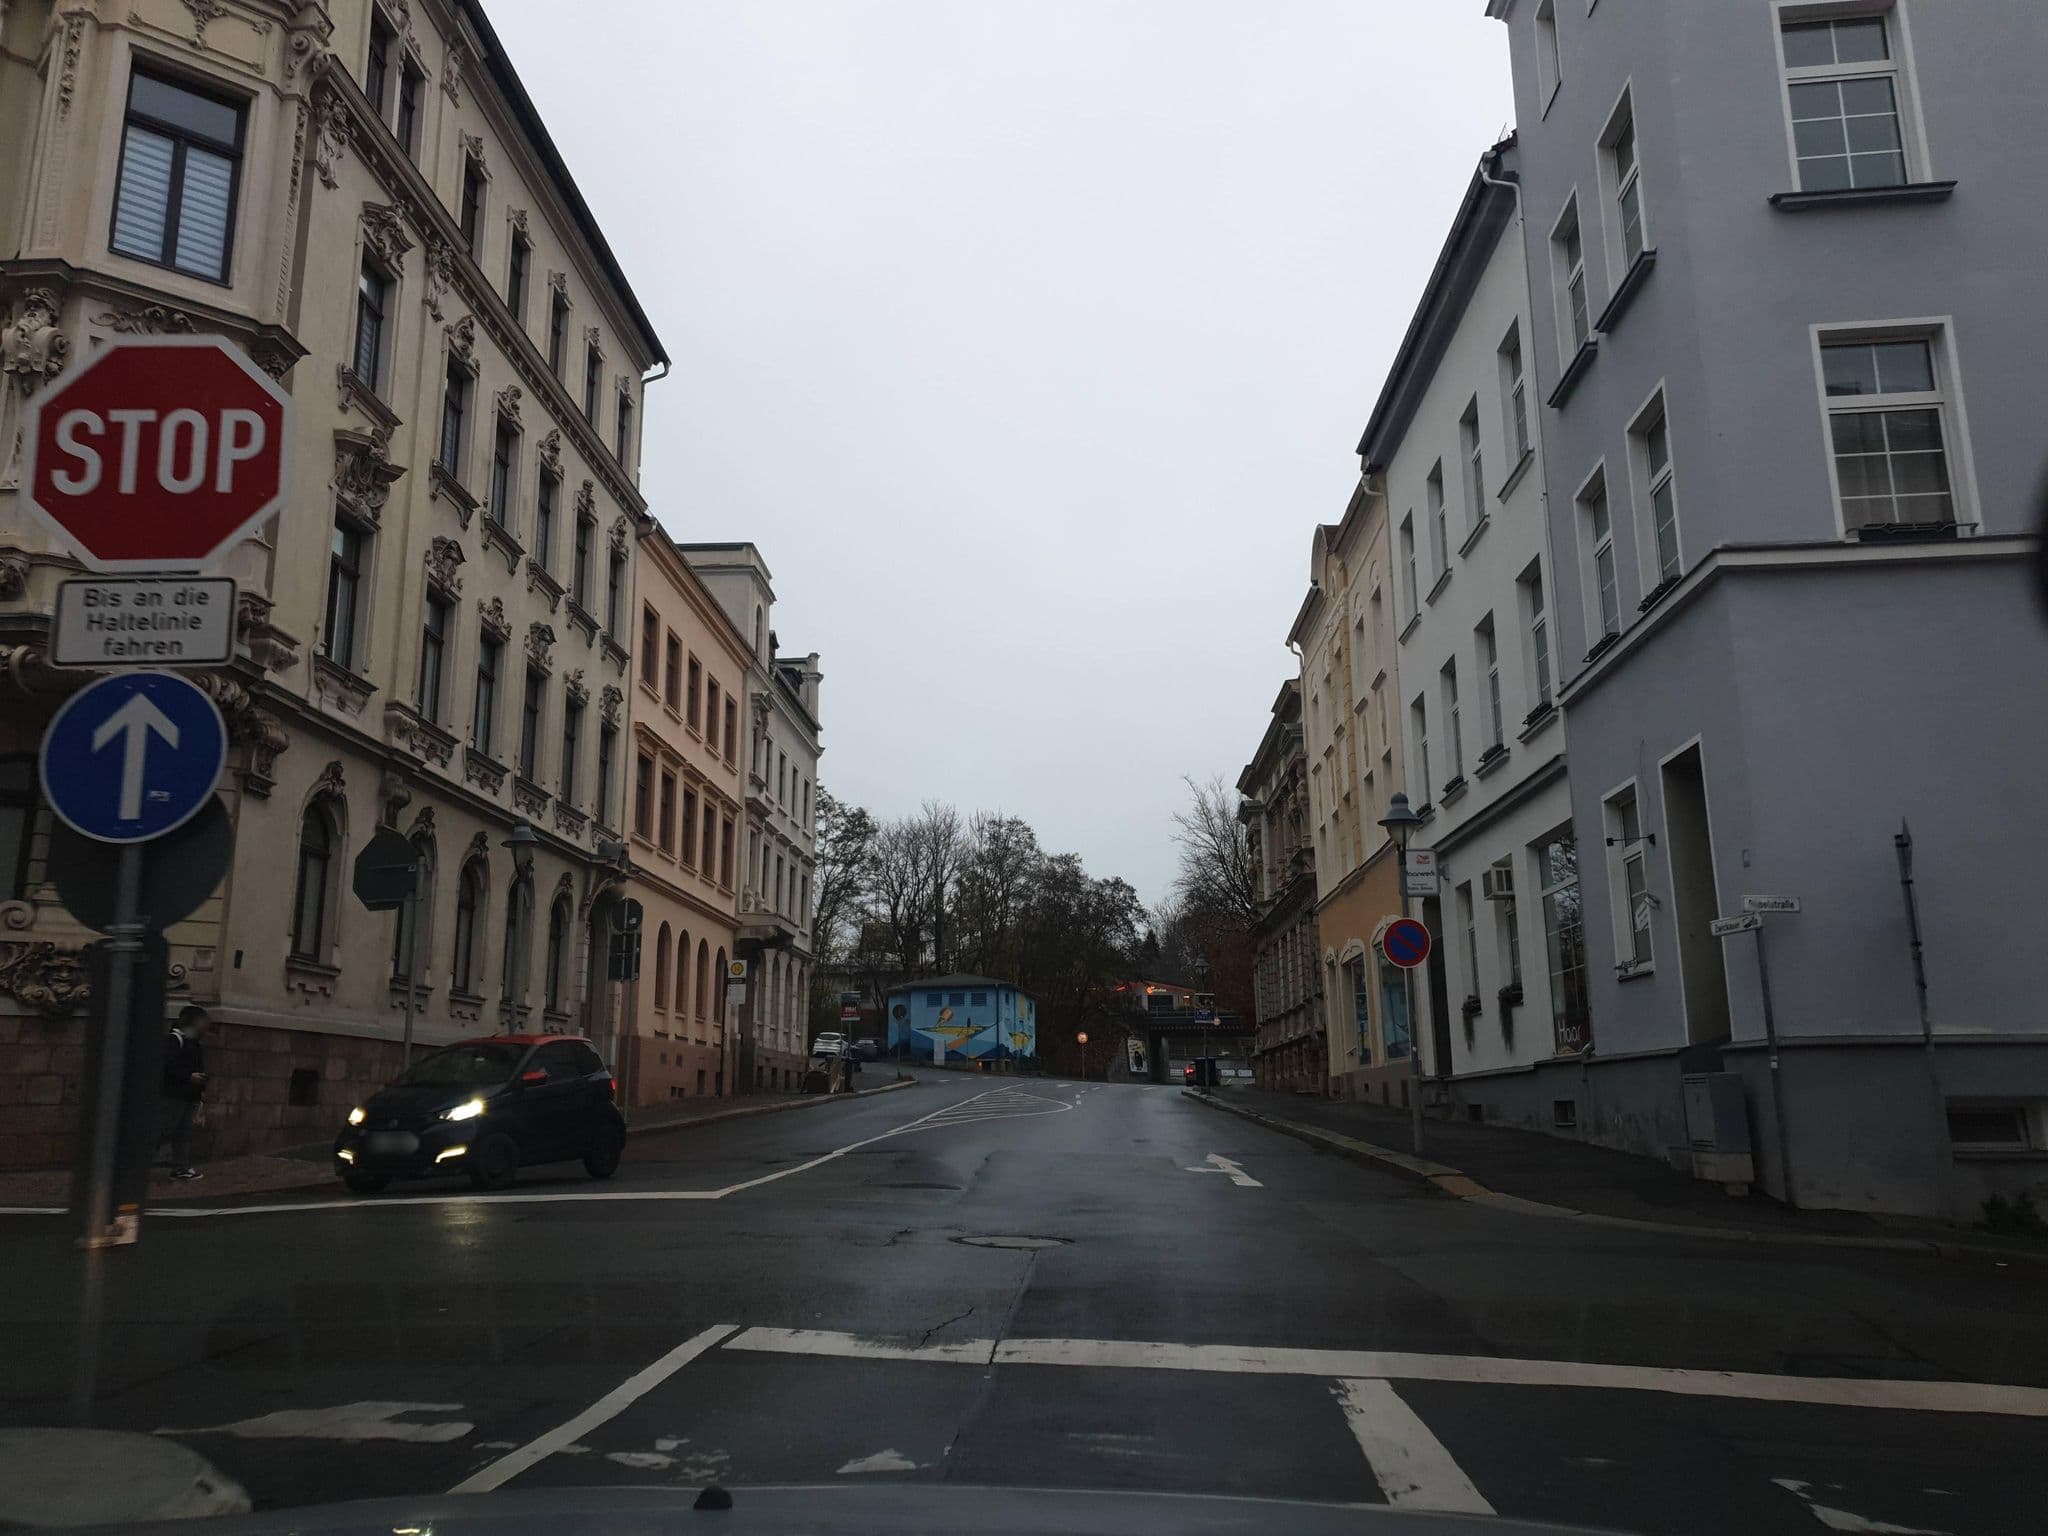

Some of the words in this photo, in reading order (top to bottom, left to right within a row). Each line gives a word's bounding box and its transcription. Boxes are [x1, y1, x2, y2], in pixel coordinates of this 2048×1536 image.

[51, 408, 266, 496] STOP
[83, 587, 121, 607] Bis
[133, 591, 162, 606] an
[173, 586, 209, 606] die
[85, 611, 202, 632] Haltelinie
[102, 637, 184, 656] fahren
